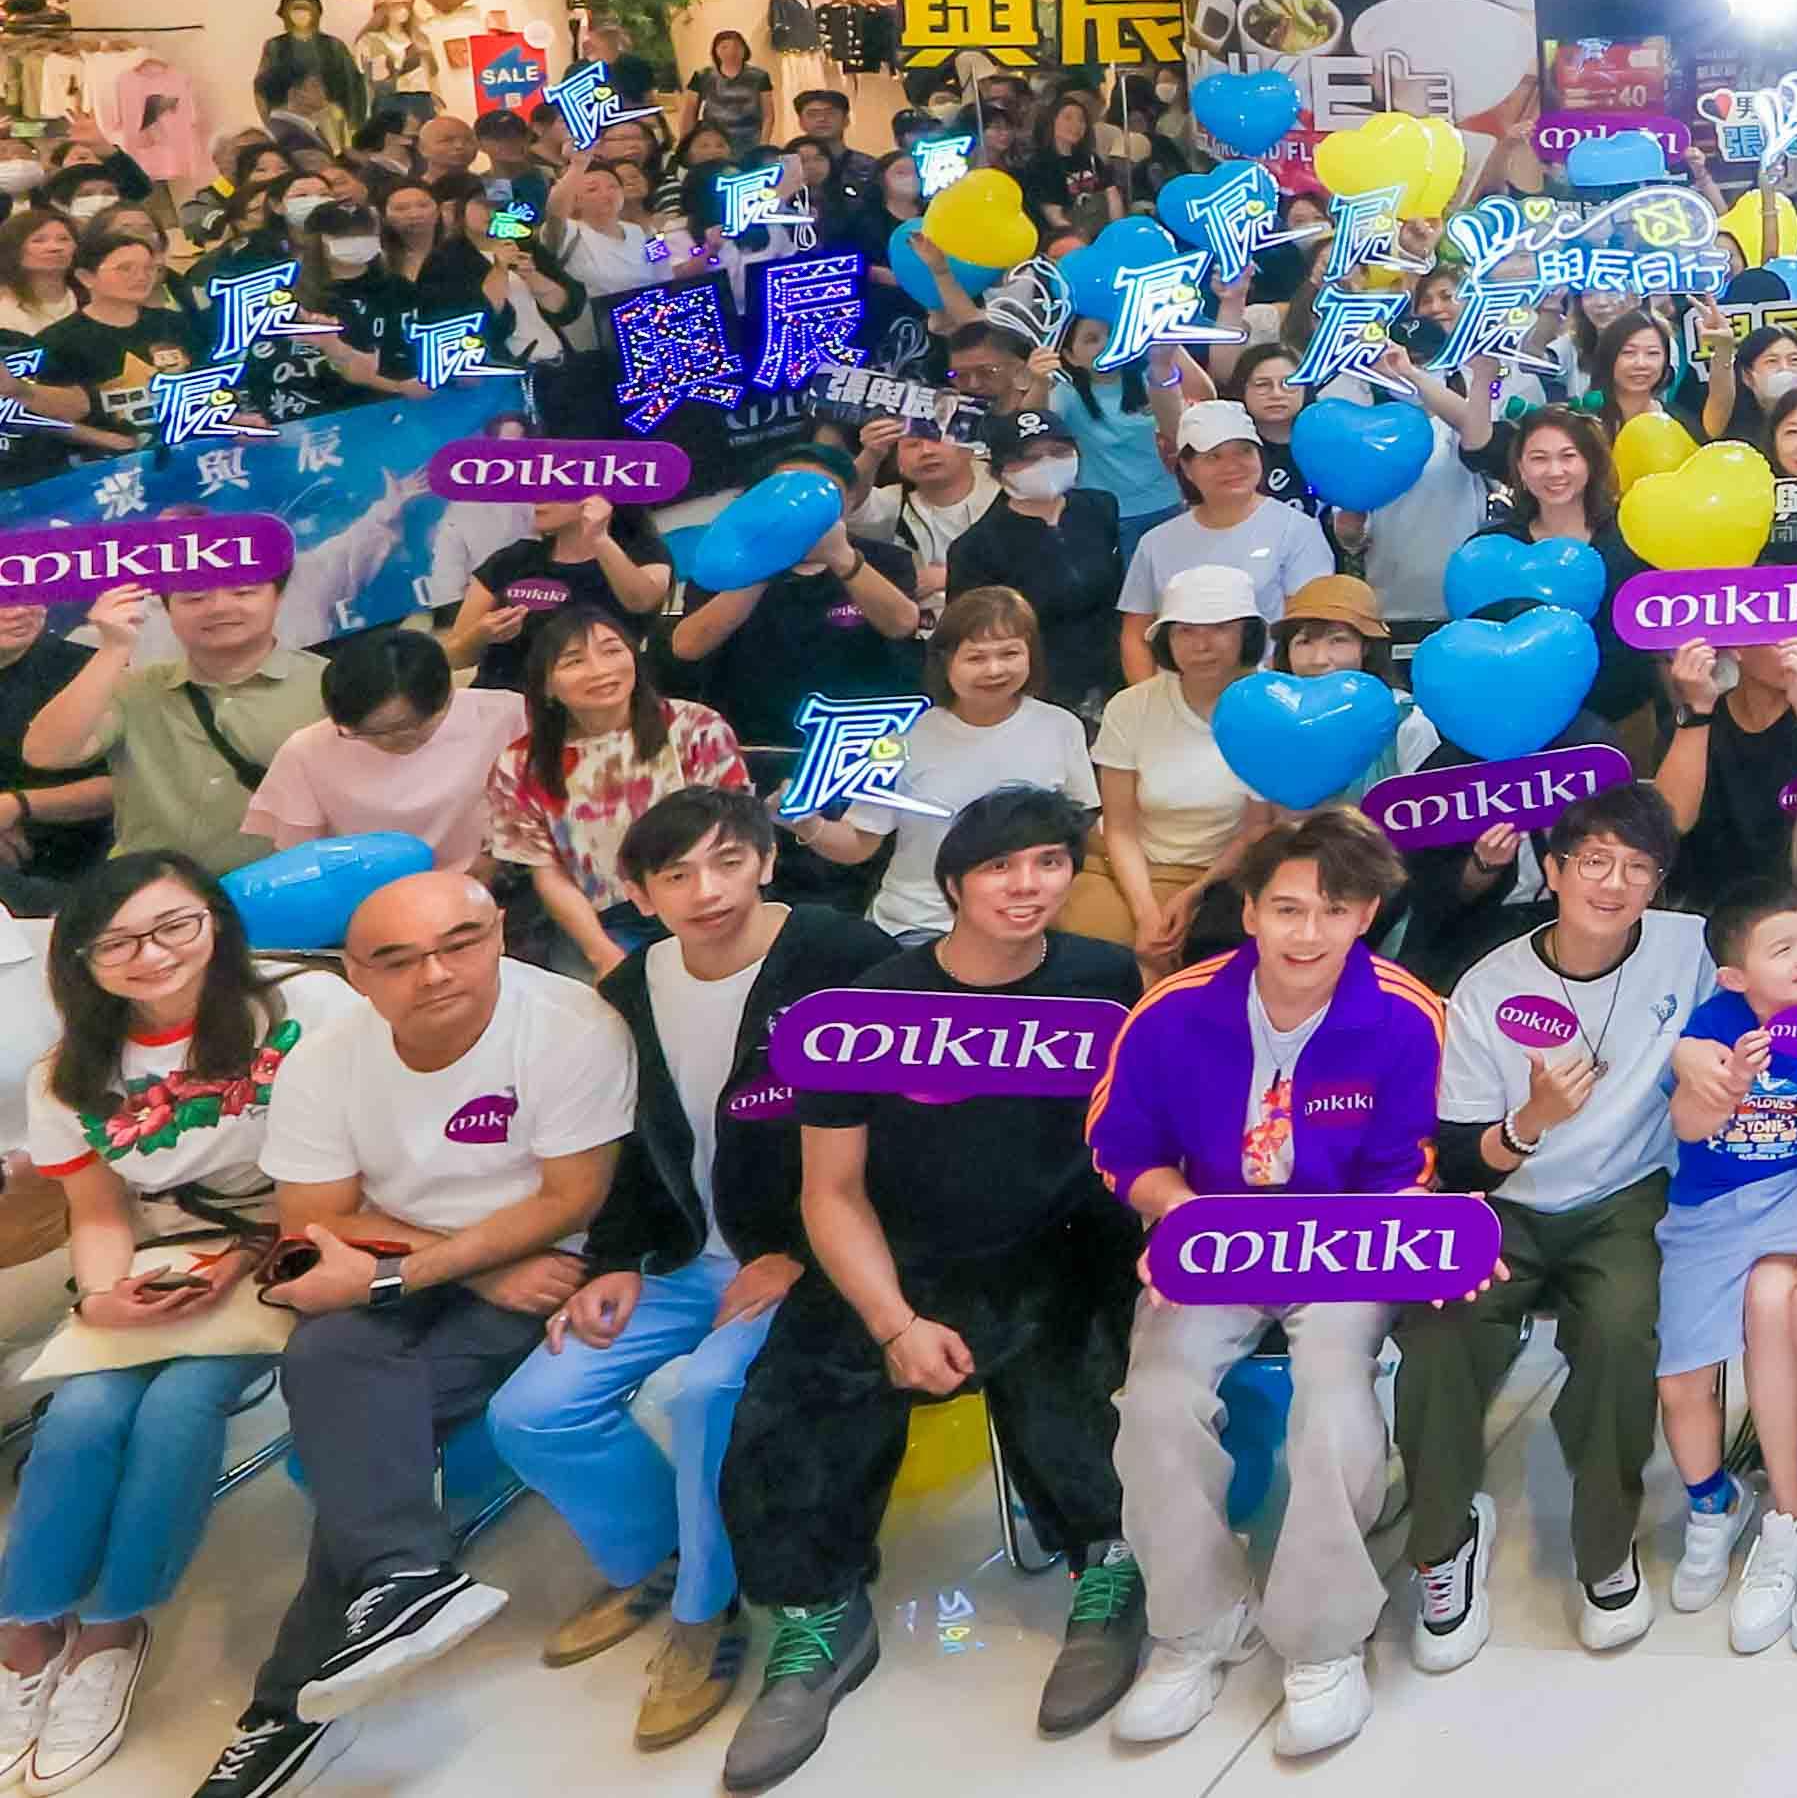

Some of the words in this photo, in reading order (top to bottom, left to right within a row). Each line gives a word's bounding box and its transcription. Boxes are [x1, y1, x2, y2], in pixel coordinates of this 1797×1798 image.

[482, 66, 540, 86] SALE
[1539, 125, 1679, 156] miki
[1538, 245, 1731, 294] 與辰同行
[94, 420, 345, 520] 張與辰
[449, 453, 660, 489] mikiki
[0, 534, 261, 586] mikiki
[507, 587, 568, 603] mikiki
[1384, 769, 1598, 839] mikiki
[1499, 1005, 1572, 1039] mikiki
[803, 1016, 1098, 1071] mikiki
[730, 1085, 793, 1112] miki
[1304, 1092, 1374, 1116] mikiki
[448, 1110, 511, 1133] mik
[1179, 1218, 1461, 1275] mikiki
